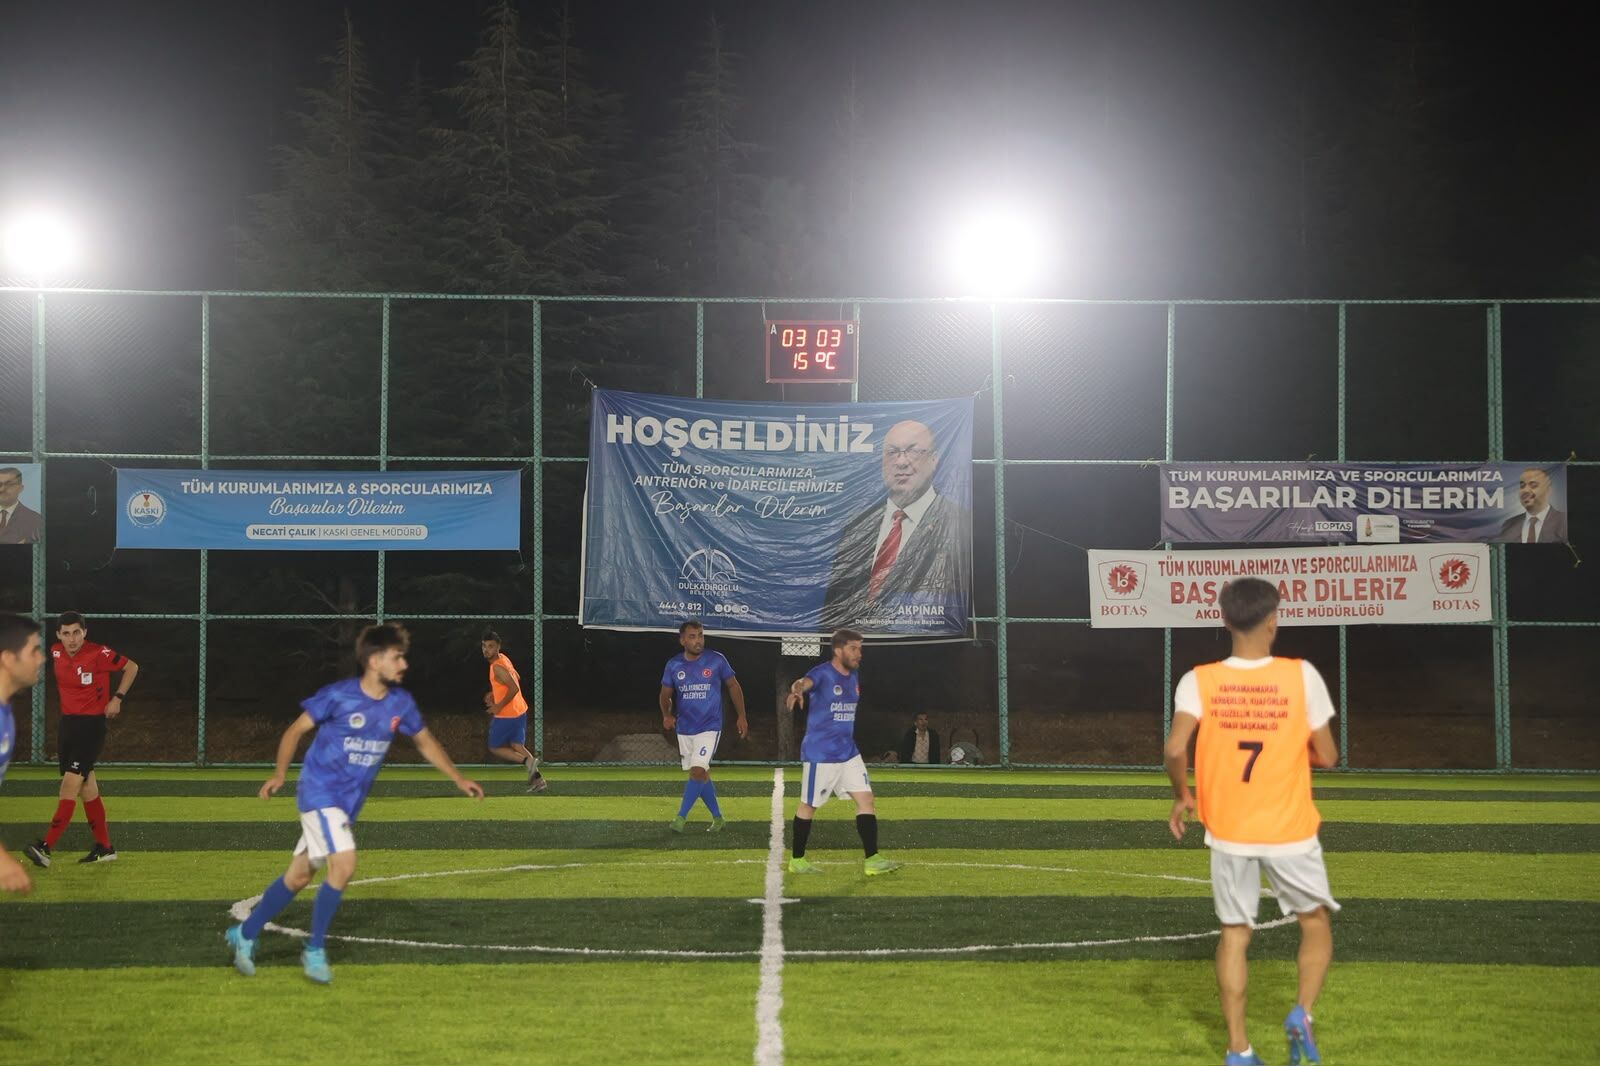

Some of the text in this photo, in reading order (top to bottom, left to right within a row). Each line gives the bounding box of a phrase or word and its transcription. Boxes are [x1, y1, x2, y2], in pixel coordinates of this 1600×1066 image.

[771, 324, 854, 347] A 03 03 B
[793, 352, 808, 369] 15
[607, 414, 874, 457] HOŞGELDİNİZ
[662, 461, 817, 479] TÜM SPORCULARIMIZA,
[1168, 470, 1503, 482] TÜM KURUMLARIMIZA VE SPORCULARIMIZA
[181, 479, 493, 495] TÜM KURUMLARIMIZA & SPORCULARIMIZA
[634, 475, 844, 493] ANTRENÖR ve İDARECİLERİMİZE
[269, 497, 405, 517] Başarılar Dilerim
[651, 490, 826, 523] Başarılar Dilerim
[1168, 486, 1357, 512] BAŞARILAR
[252, 527, 286, 536] NECATİ
[288, 528, 316, 538] ÇALIK
[350, 528, 381, 537] GENEL
[382, 527, 422, 537] MÜDÜRÜ
[1316, 522, 1352, 531] TOPTAŞ
[1158, 555, 1418, 577] TÜM KURUMLARIMIZA VE SPORCULARIMIZA
[660, 602, 702, 610] 444 9 812
[897, 605, 945, 616] AKPINAR
[1100, 605, 1148, 617] BOTAŞ
[1307, 604, 1384, 618] MÜDÜRLÜĞÜ
[1432, 599, 1480, 611] BOTAŞ
[699, 746, 707, 756] 6
[1238, 741, 1264, 783] 7
